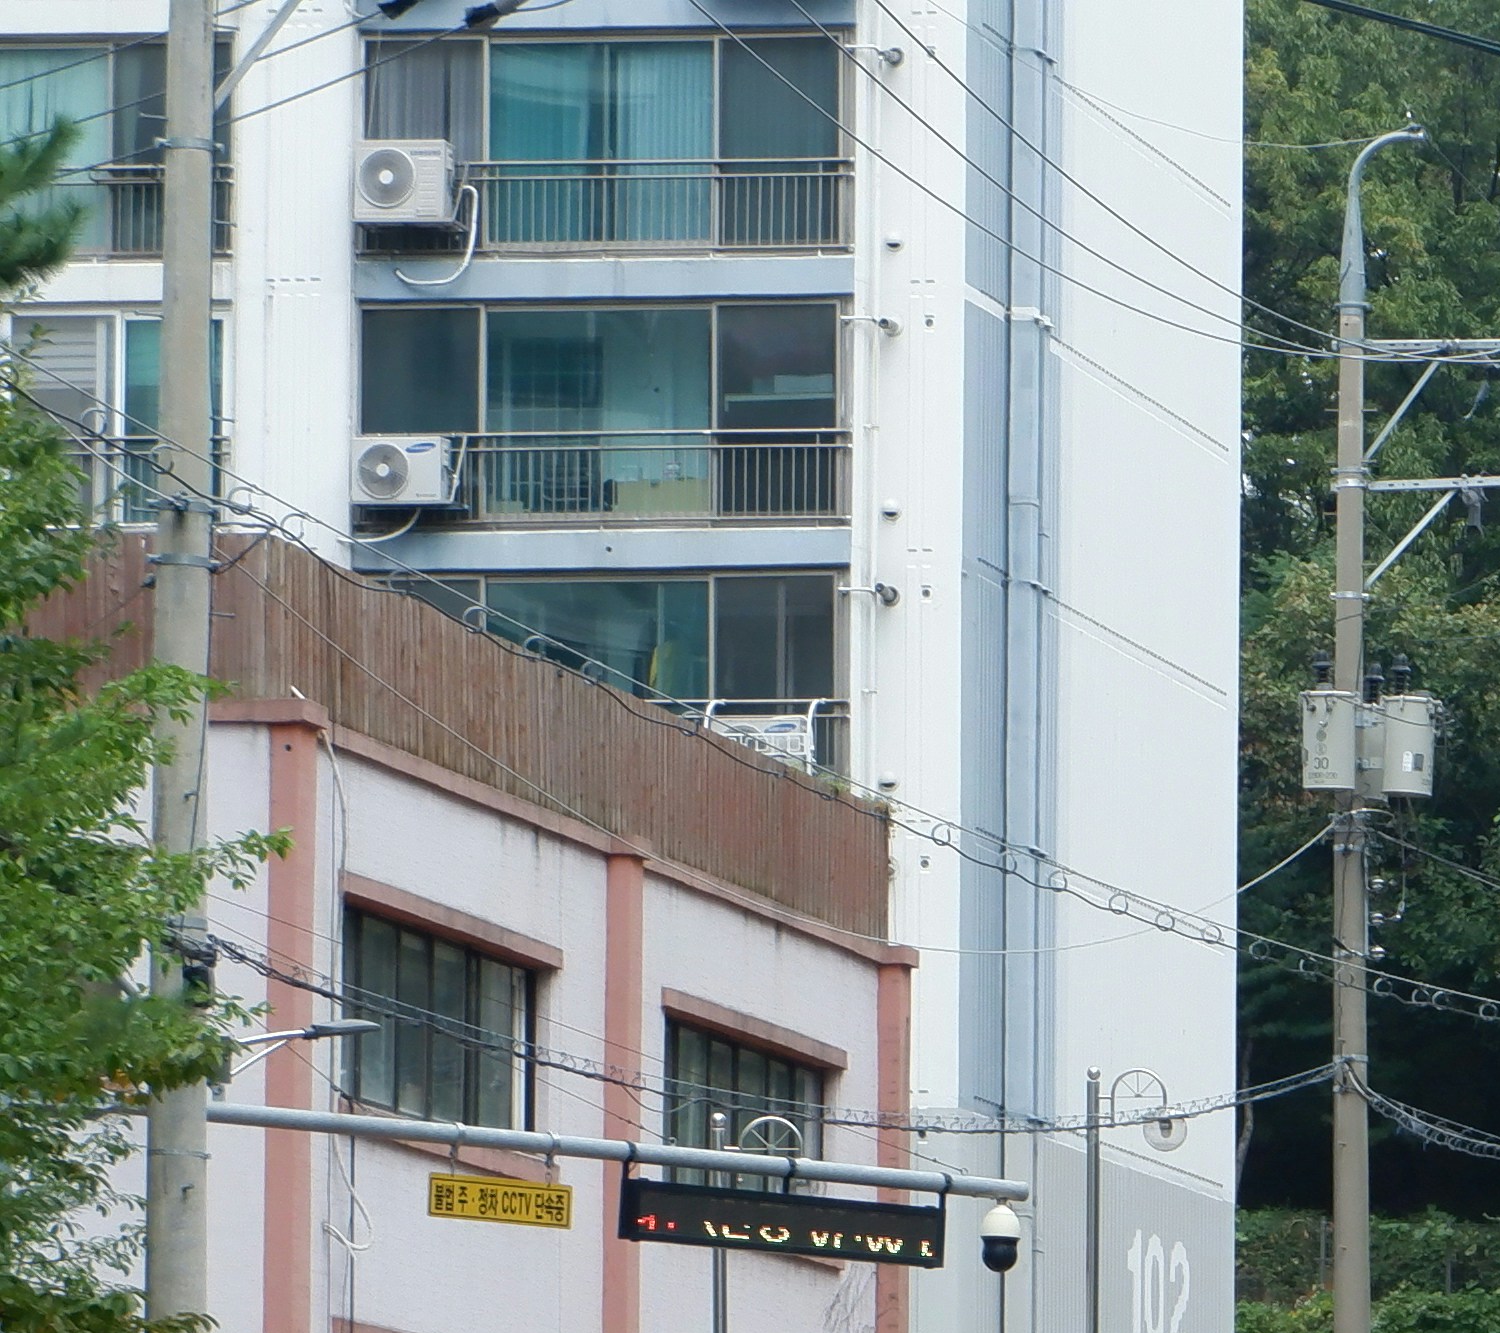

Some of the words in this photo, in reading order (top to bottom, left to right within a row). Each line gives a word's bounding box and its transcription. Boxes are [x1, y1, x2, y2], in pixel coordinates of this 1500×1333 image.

[434, 1183, 455, 1212] 불법
[501, 1190, 532, 1216] CCTV
[534, 1193, 565, 1223] 단속중
